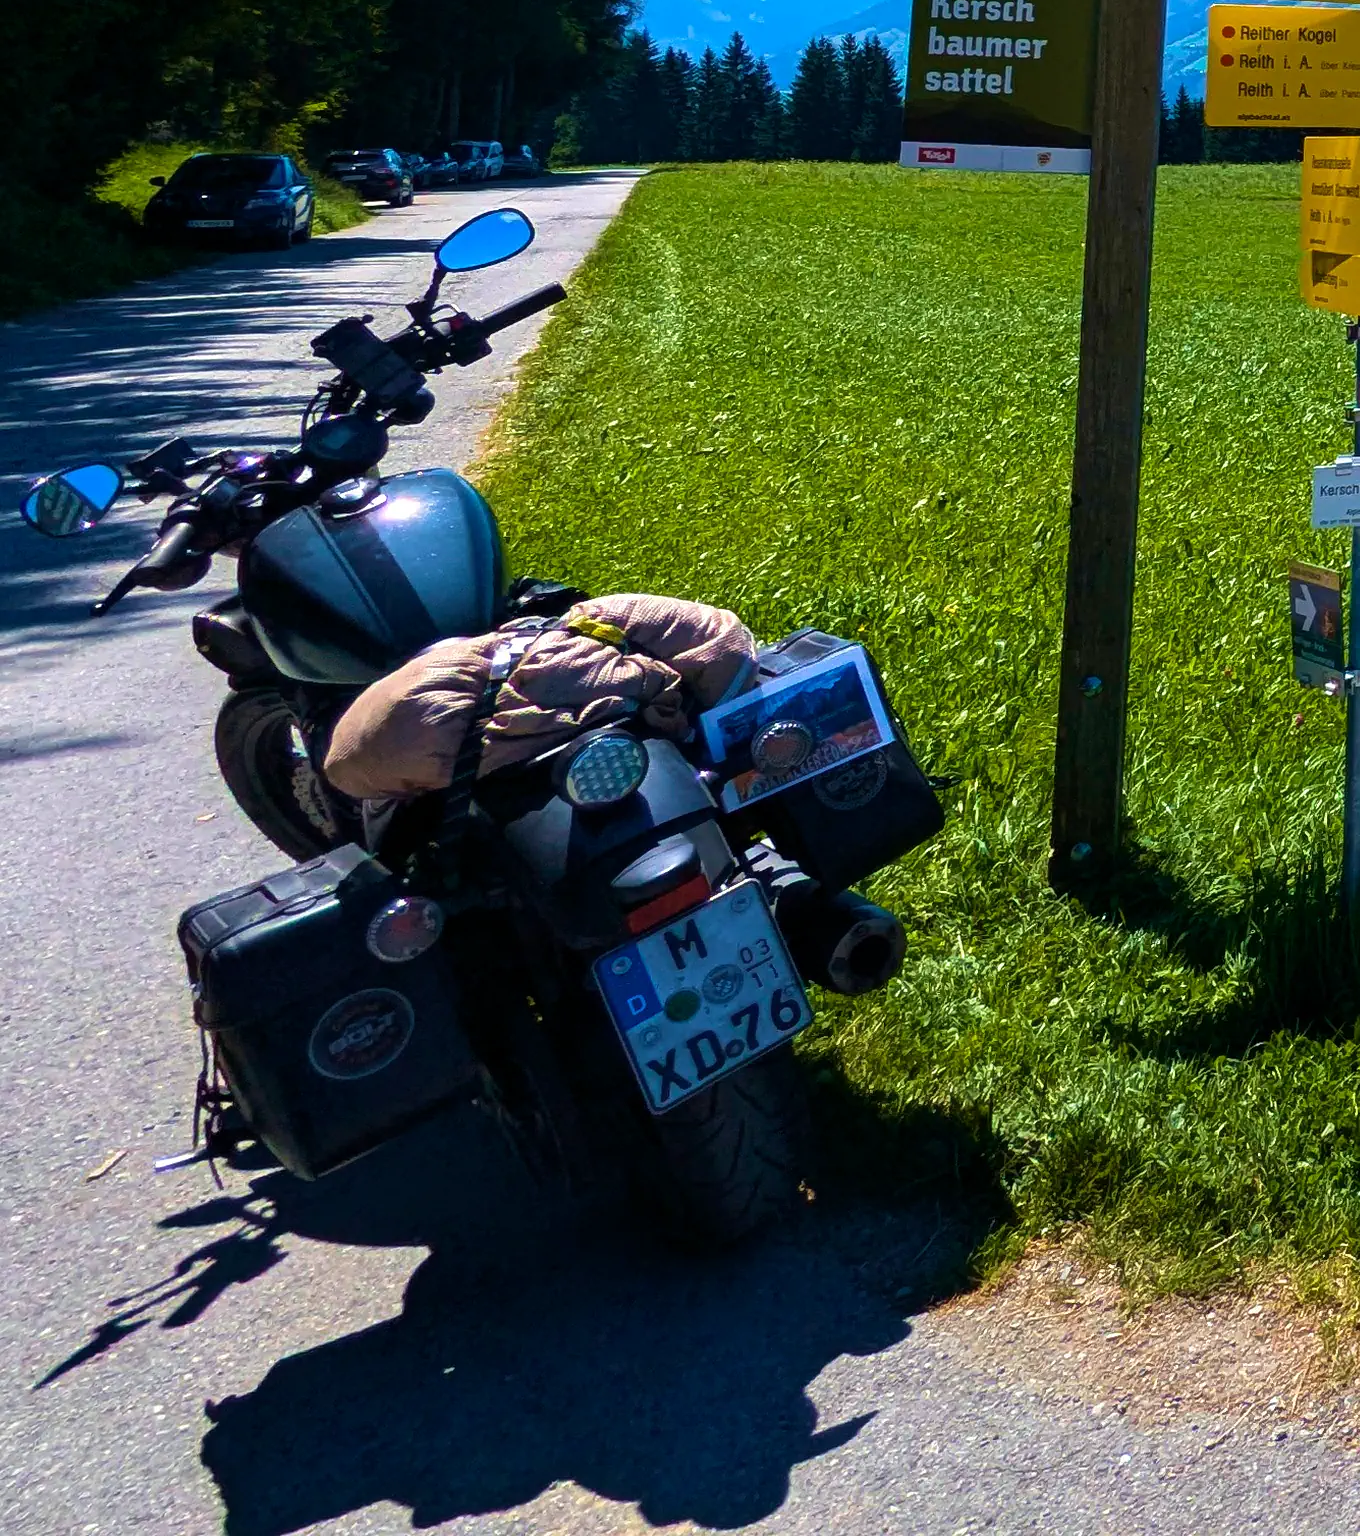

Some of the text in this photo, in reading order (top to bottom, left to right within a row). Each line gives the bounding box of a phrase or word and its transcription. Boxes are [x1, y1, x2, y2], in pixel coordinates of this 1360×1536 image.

[928, 26, 1048, 59] baumer
[1240, 26, 1290, 41] Reither
[1298, 27, 1336, 44] Kogel
[1239, 54, 1275, 69] Reith
[1283, 55, 1291, 69] i.
[1299, 55, 1312, 69] A.
[925, 66, 1013, 94] sattel
[1238, 82, 1273, 97] Reith
[1283, 83, 1290, 98] i.
[1298, 83, 1311, 98] A.
[663, 918, 708, 970] M
[740, 938, 771, 964] 03
[752, 963, 779, 988] 11
[626, 994, 647, 1015] D
[646, 987, 801, 1103] XD 76
